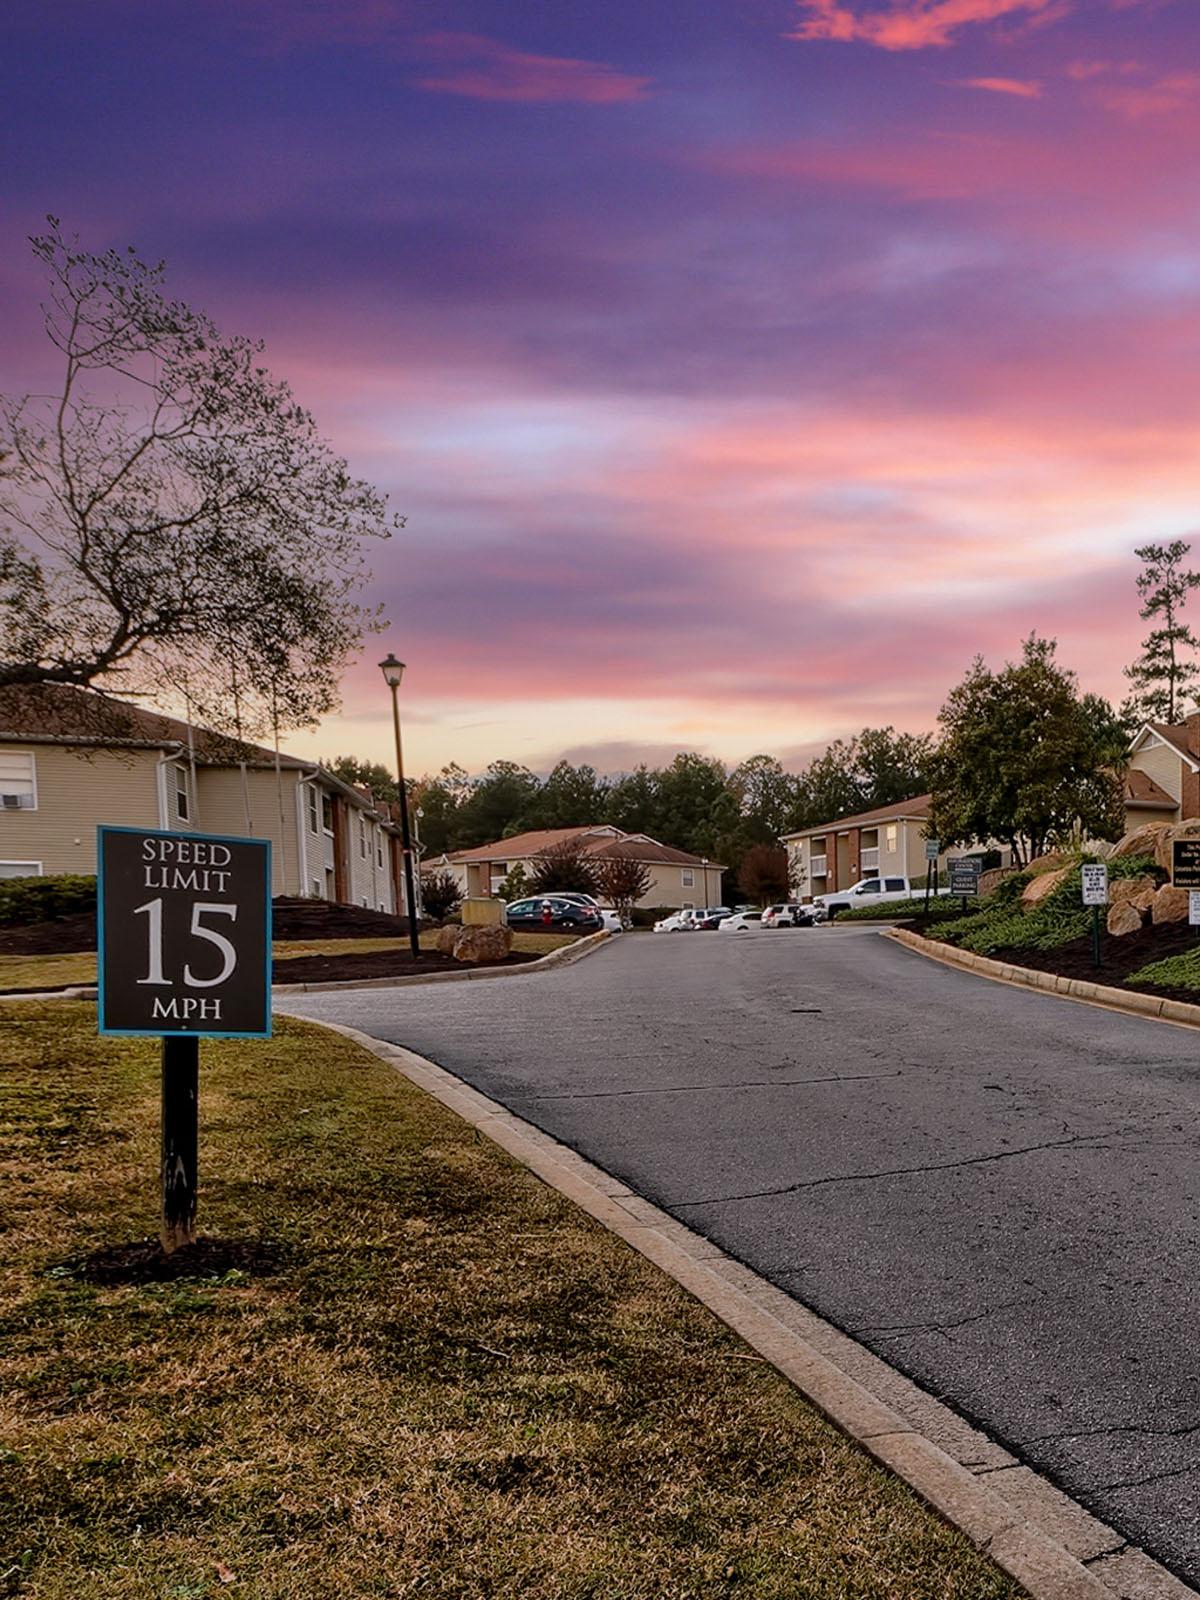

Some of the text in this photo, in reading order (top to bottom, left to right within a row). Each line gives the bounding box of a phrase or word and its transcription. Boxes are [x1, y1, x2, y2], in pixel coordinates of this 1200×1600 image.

[142, 838, 232, 867] SPEED
[144, 865, 232, 893] LIMIT
[133, 897, 237, 988] 15
[152, 996, 222, 1020] MPH
